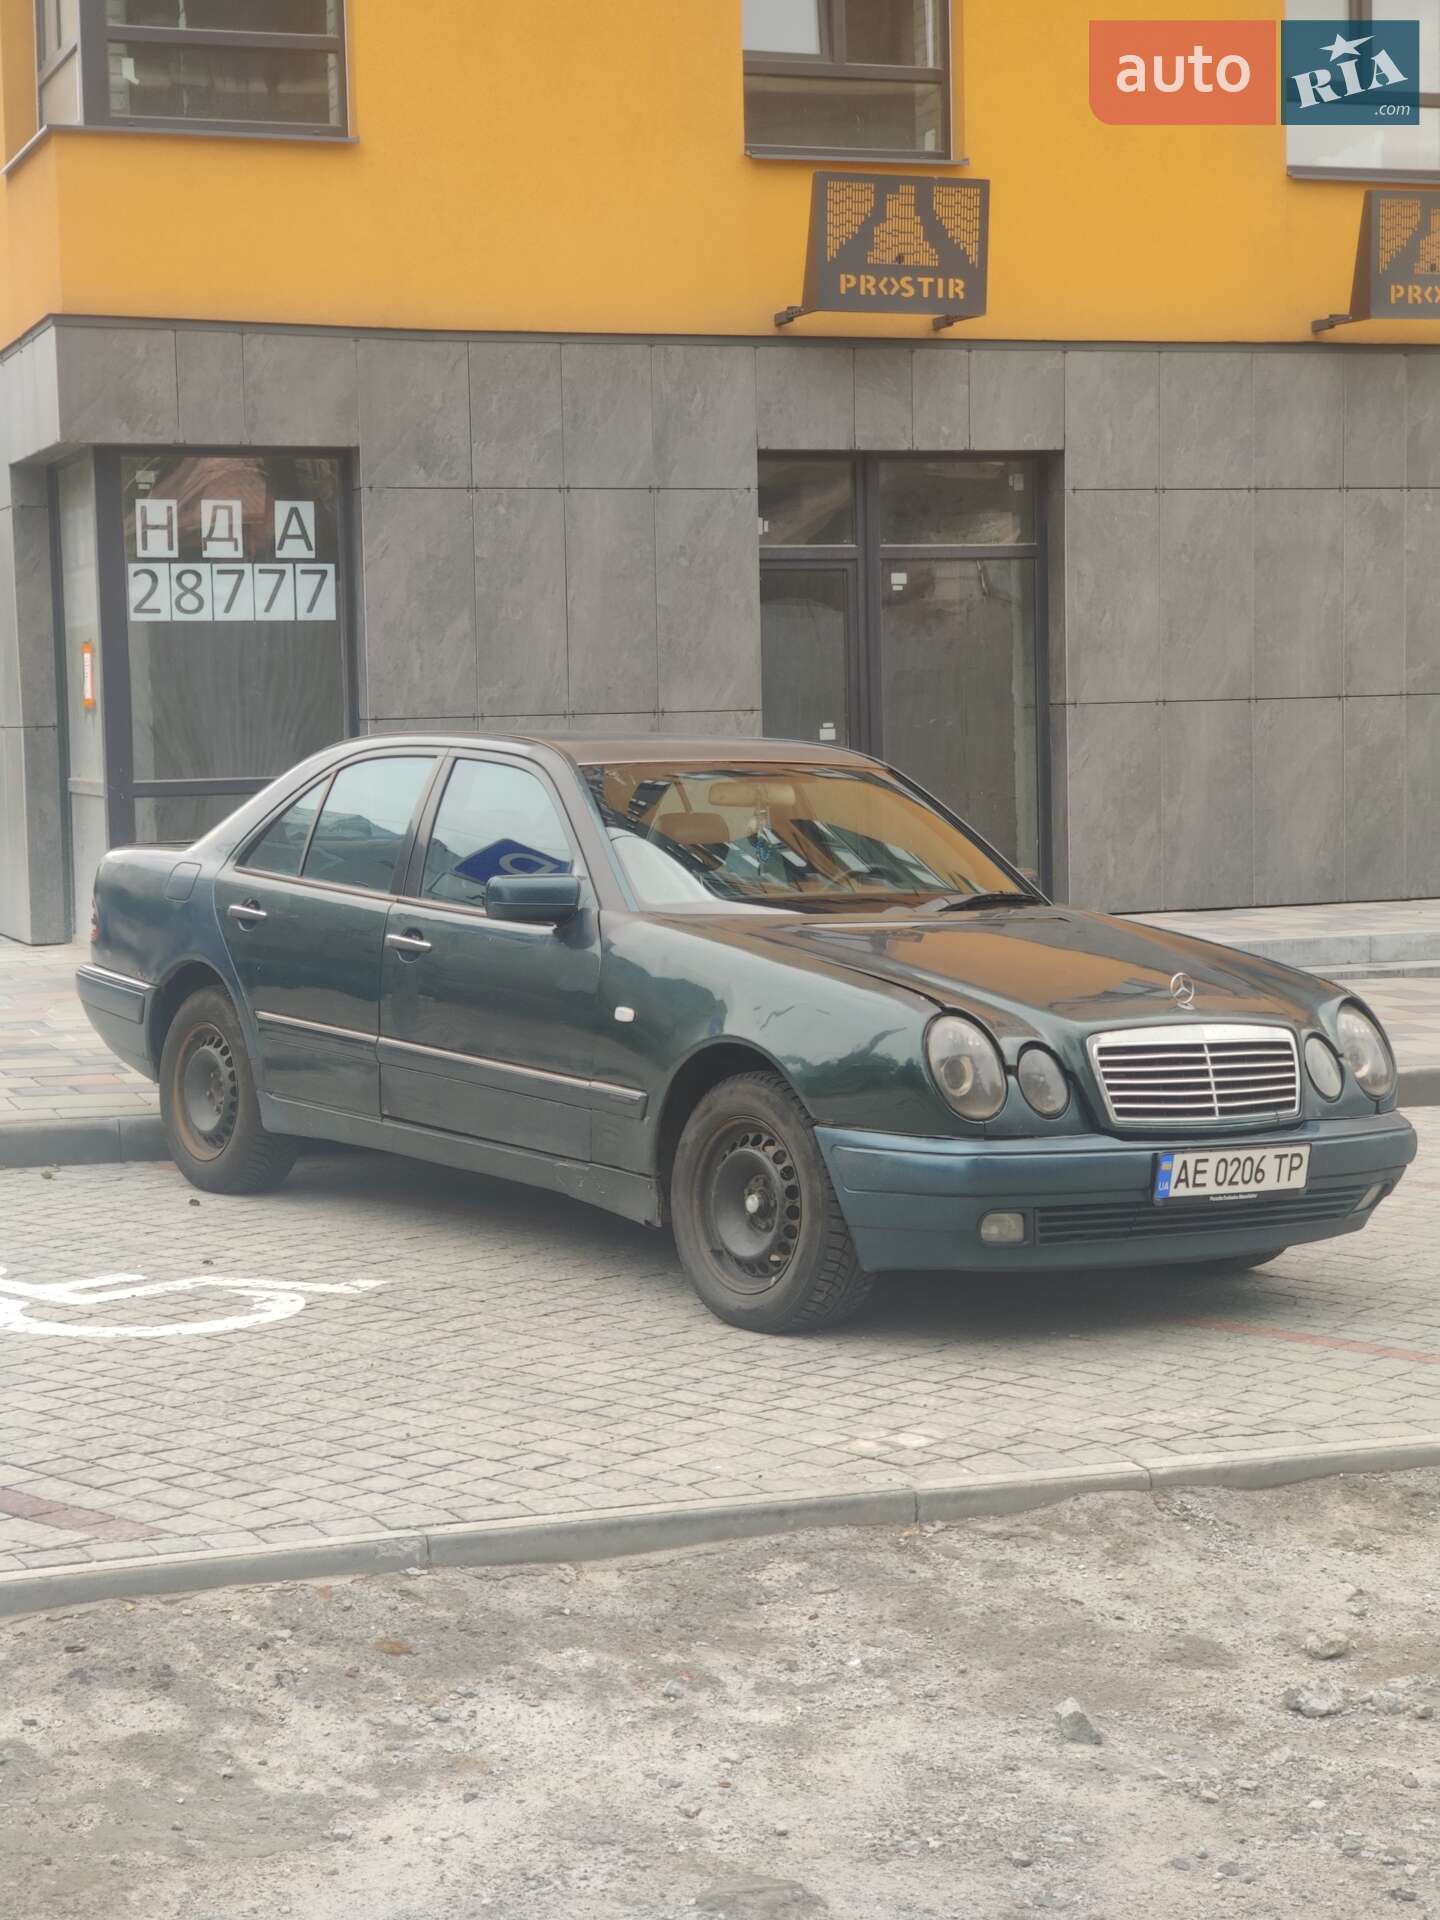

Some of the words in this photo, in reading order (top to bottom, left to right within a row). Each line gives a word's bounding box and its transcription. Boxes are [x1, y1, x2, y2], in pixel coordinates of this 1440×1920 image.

[839, 273, 966, 300] PROSTIR
[132, 568, 328, 614] 28777
[1158, 1182, 1169, 1191] UA
[1173, 1158, 1209, 1189] AE
[1214, 1155, 1267, 1187] 0206
[1273, 1152, 1304, 1183] TP
